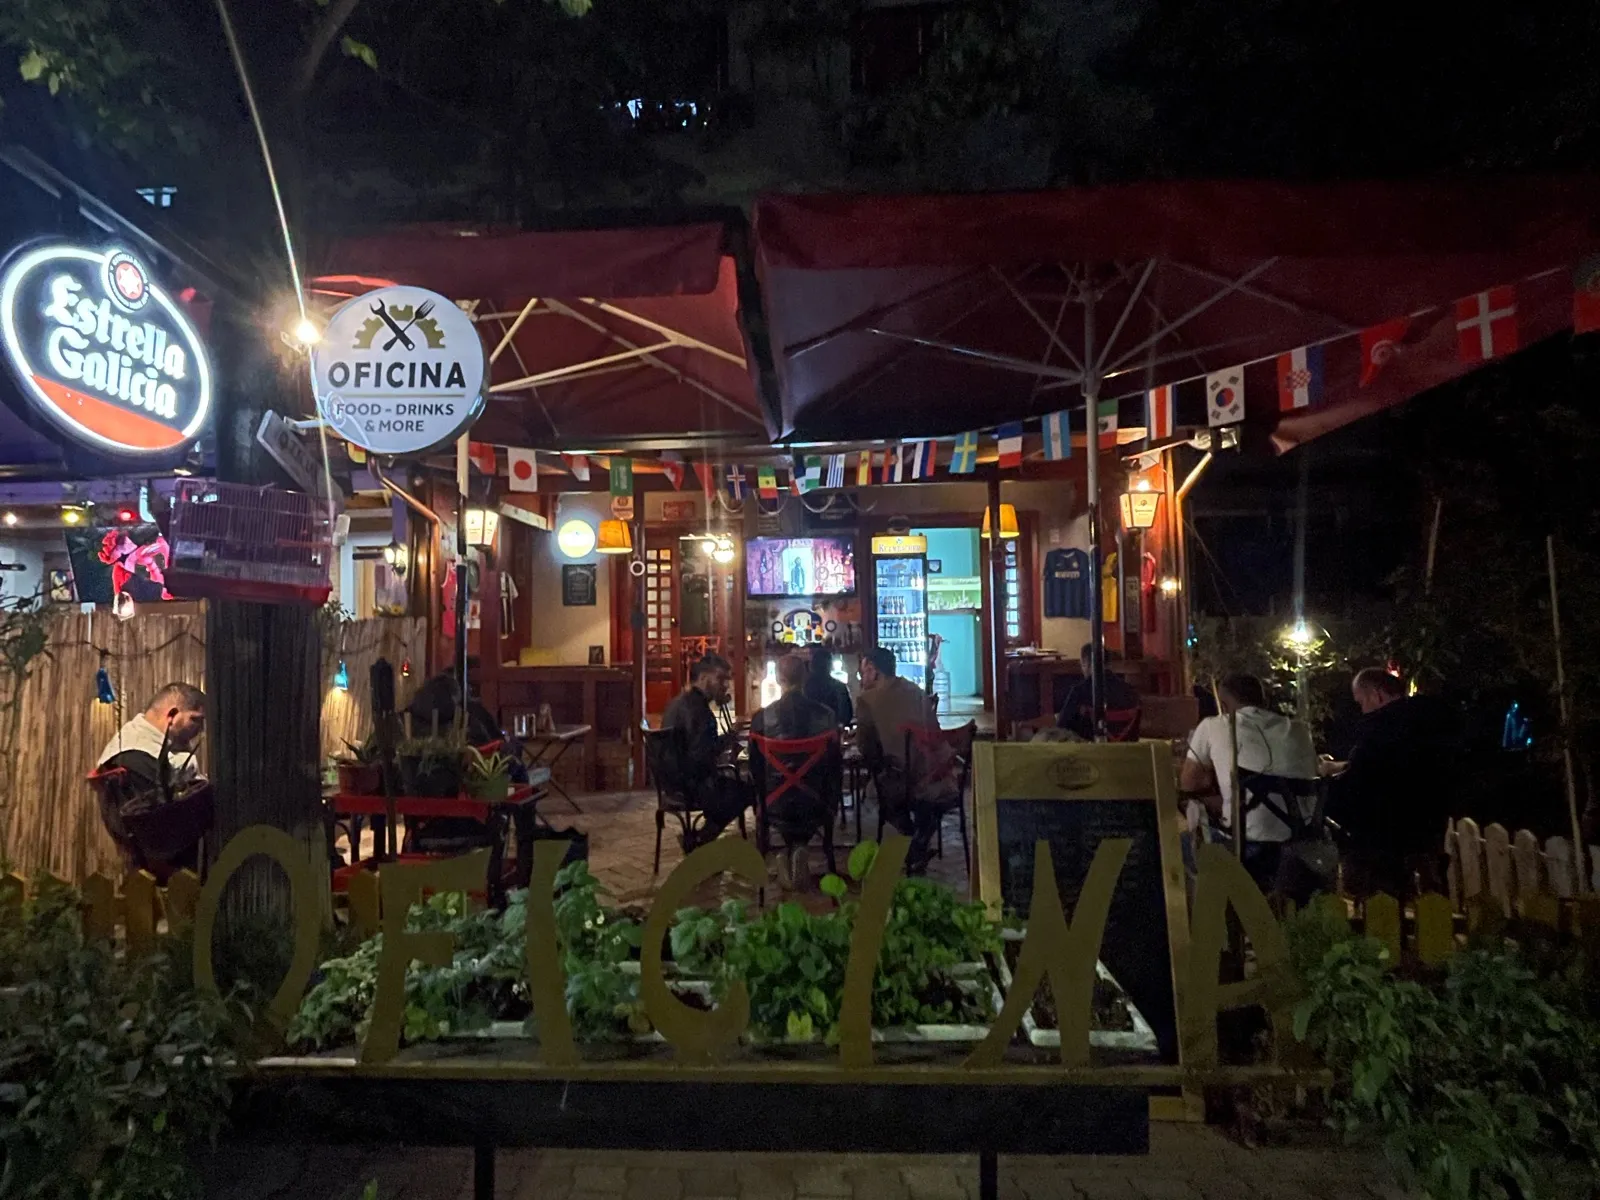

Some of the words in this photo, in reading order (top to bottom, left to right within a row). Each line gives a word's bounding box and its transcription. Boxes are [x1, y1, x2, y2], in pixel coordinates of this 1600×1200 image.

[44, 275, 185, 380] Estrella
[50, 327, 177, 419] Galicia
[328, 361, 467, 388] OFICINA
[336, 403, 381, 416] FOOD
[396, 403, 454, 416] DRINKS
[364, 420, 375, 432] &
[378, 420, 425, 432] MORE
[192, 824, 1293, 1068] OFICINA
